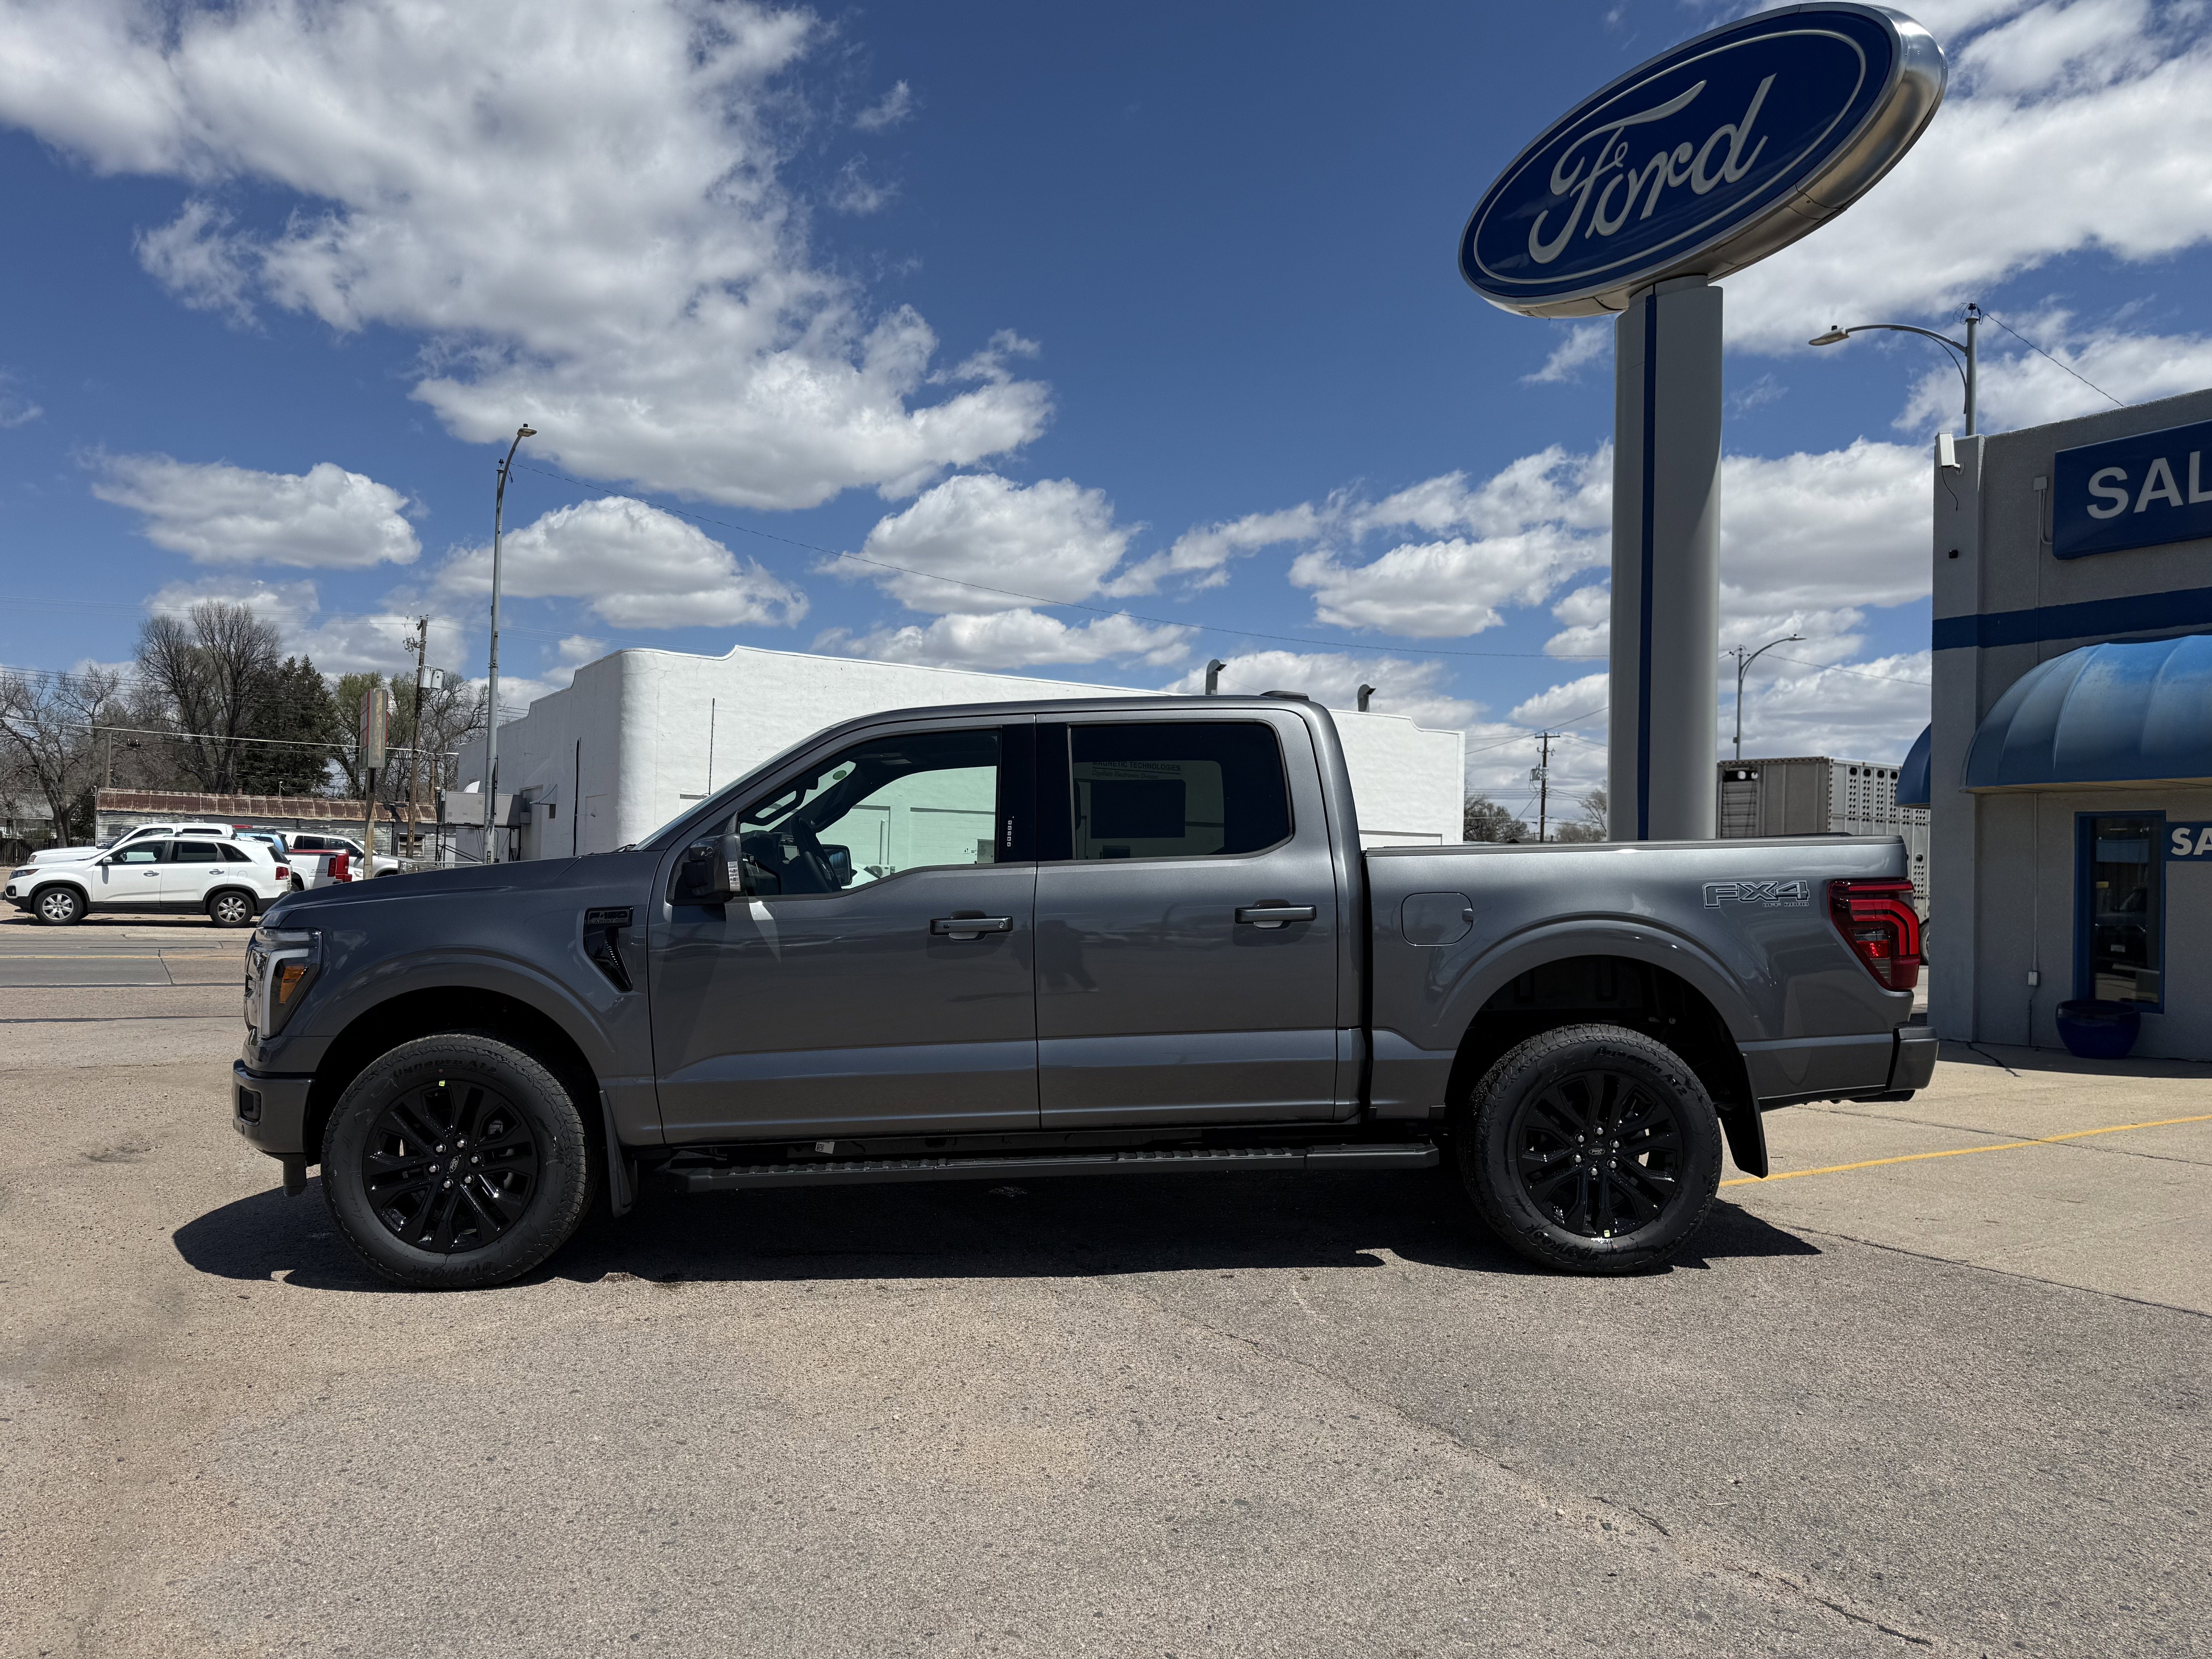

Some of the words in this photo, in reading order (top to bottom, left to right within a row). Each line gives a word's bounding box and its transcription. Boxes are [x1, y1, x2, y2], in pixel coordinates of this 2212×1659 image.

[1528, 72, 1777, 264] Ford
[1130, 761, 1181, 771] TECHNOLOGIES
[1702, 880, 1810, 908] FX4
